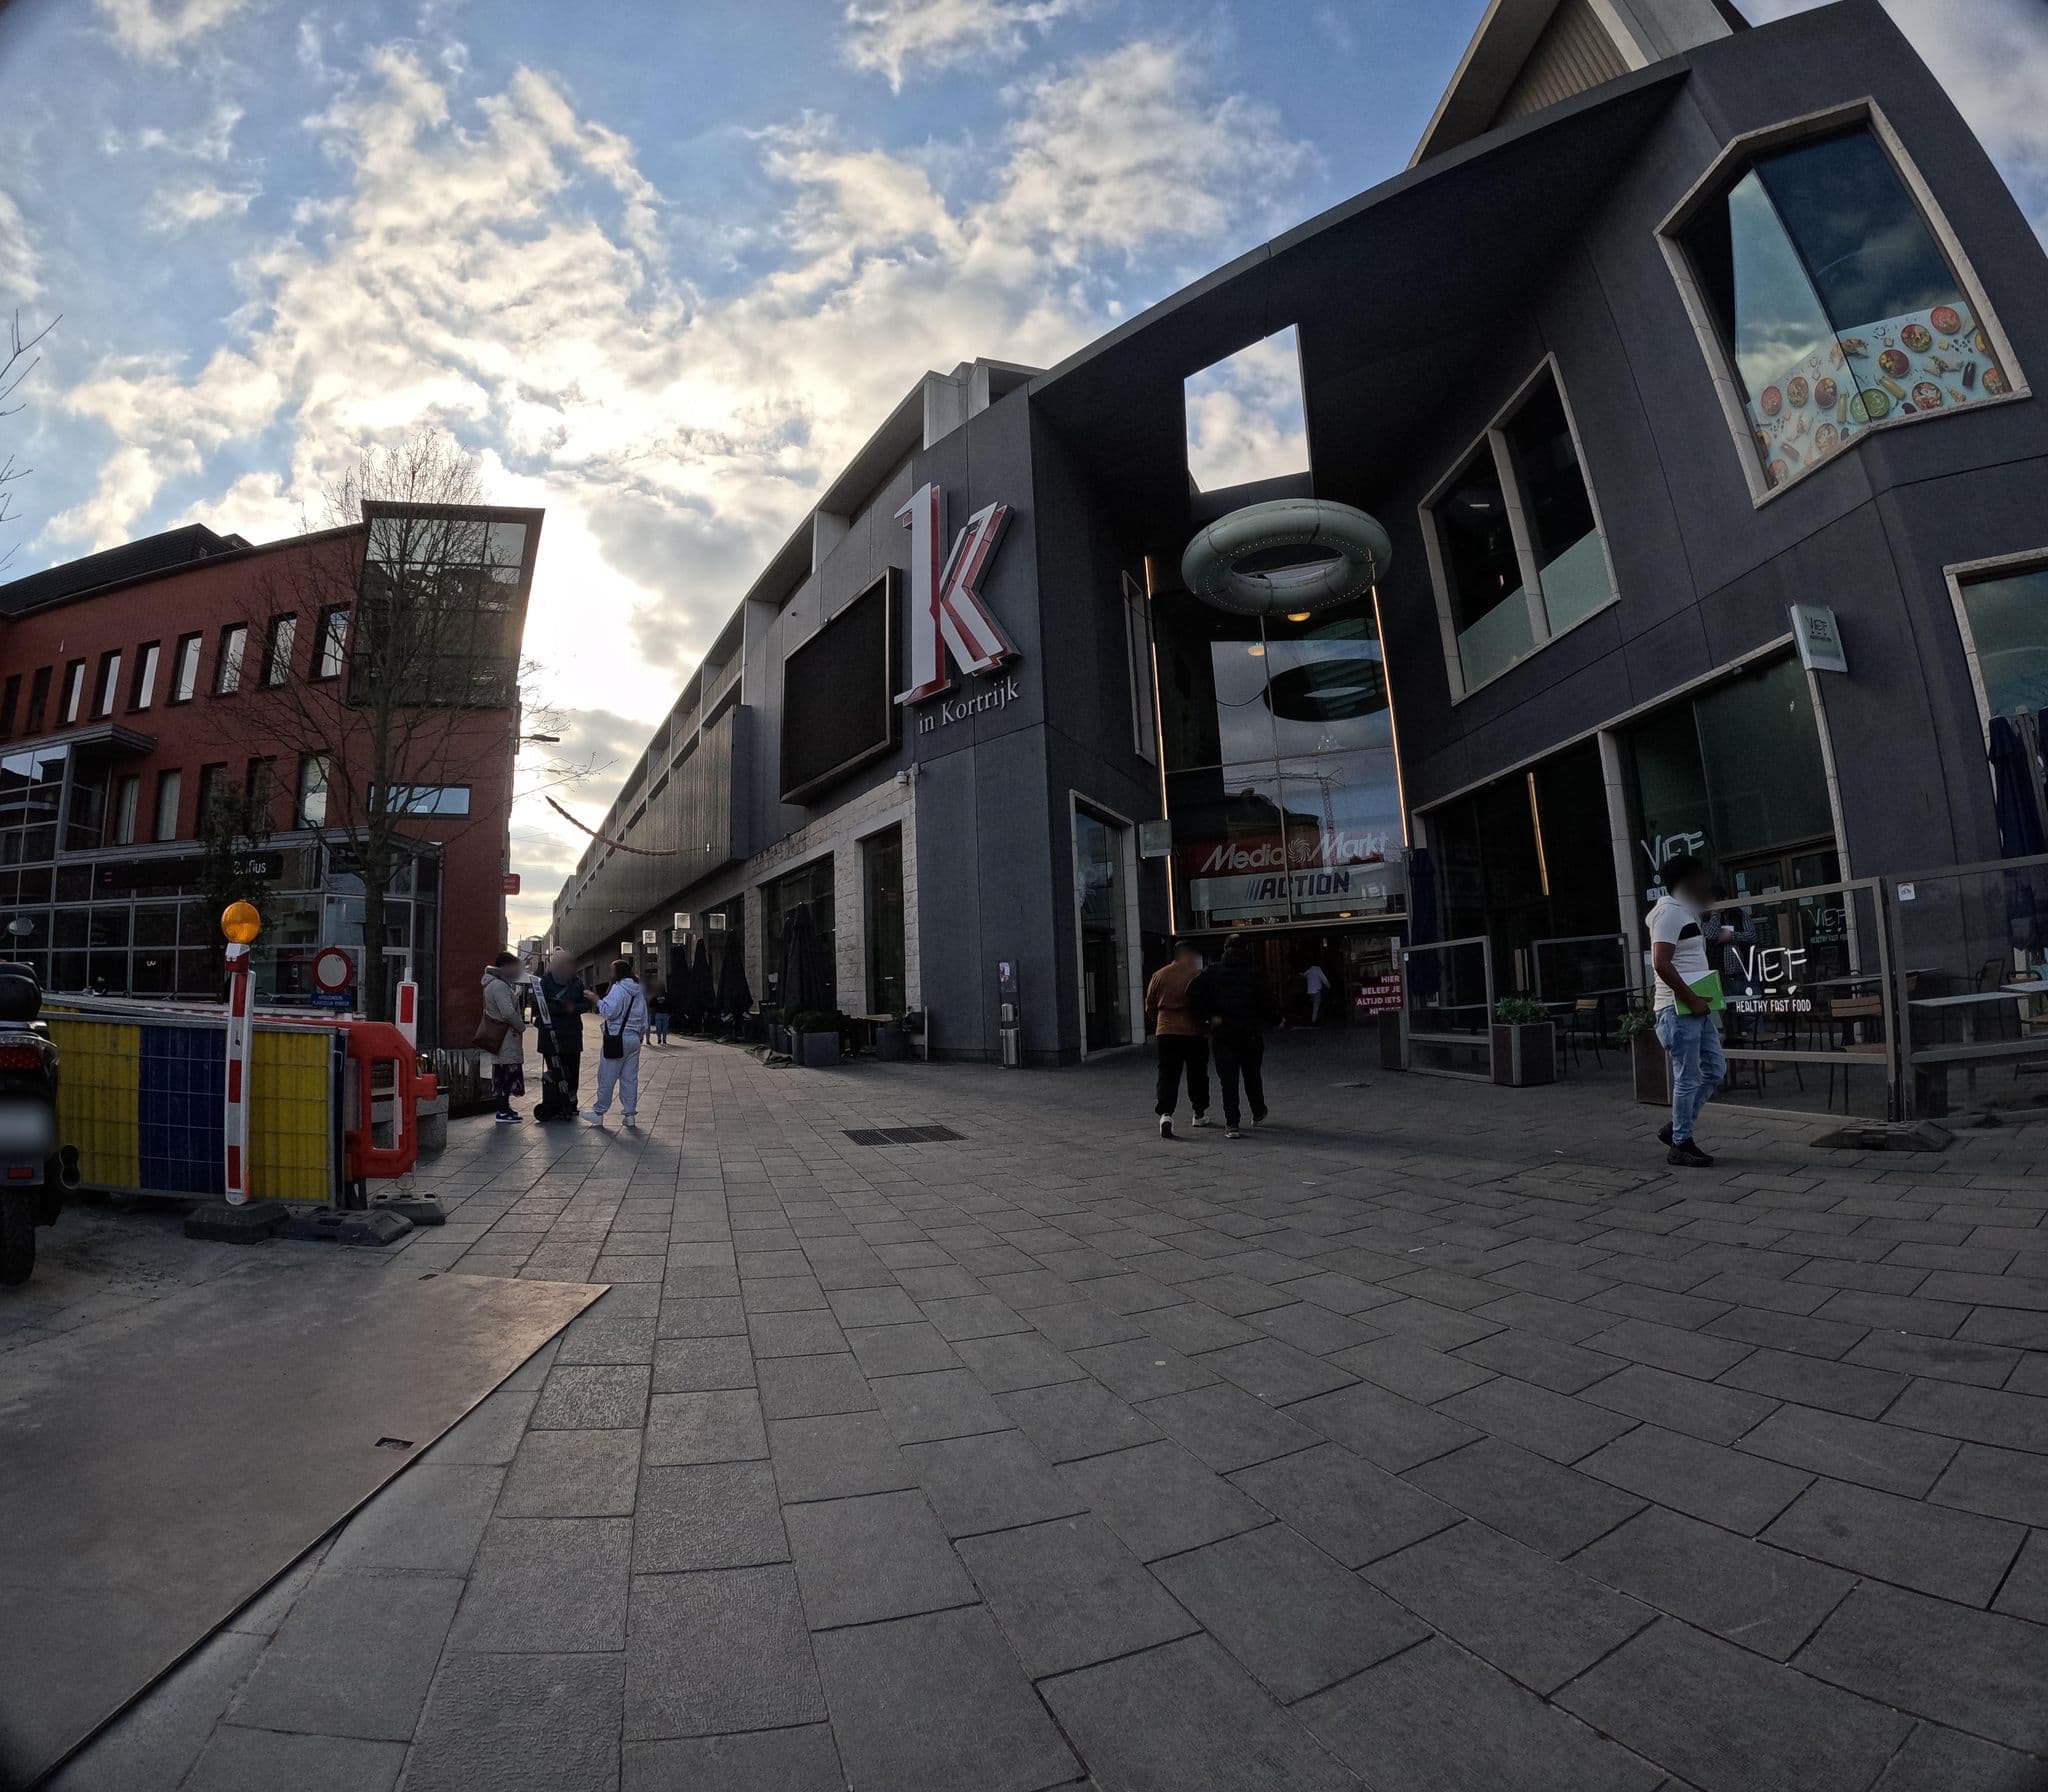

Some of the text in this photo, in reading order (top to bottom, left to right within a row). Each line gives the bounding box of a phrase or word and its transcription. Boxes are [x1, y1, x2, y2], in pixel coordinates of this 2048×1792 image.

[919, 676, 1019, 735] in Kortrijk
[1201, 843, 1285, 873] Media
[1732, 945, 1807, 982] VIEF
[1381, 975, 1401, 983] HIER
[1362, 987, 1390, 995] BELEEF
[1356, 998, 1383, 1006] ALTIJD
[1736, 999, 1811, 1012] HEALTHY FAST FOOD
